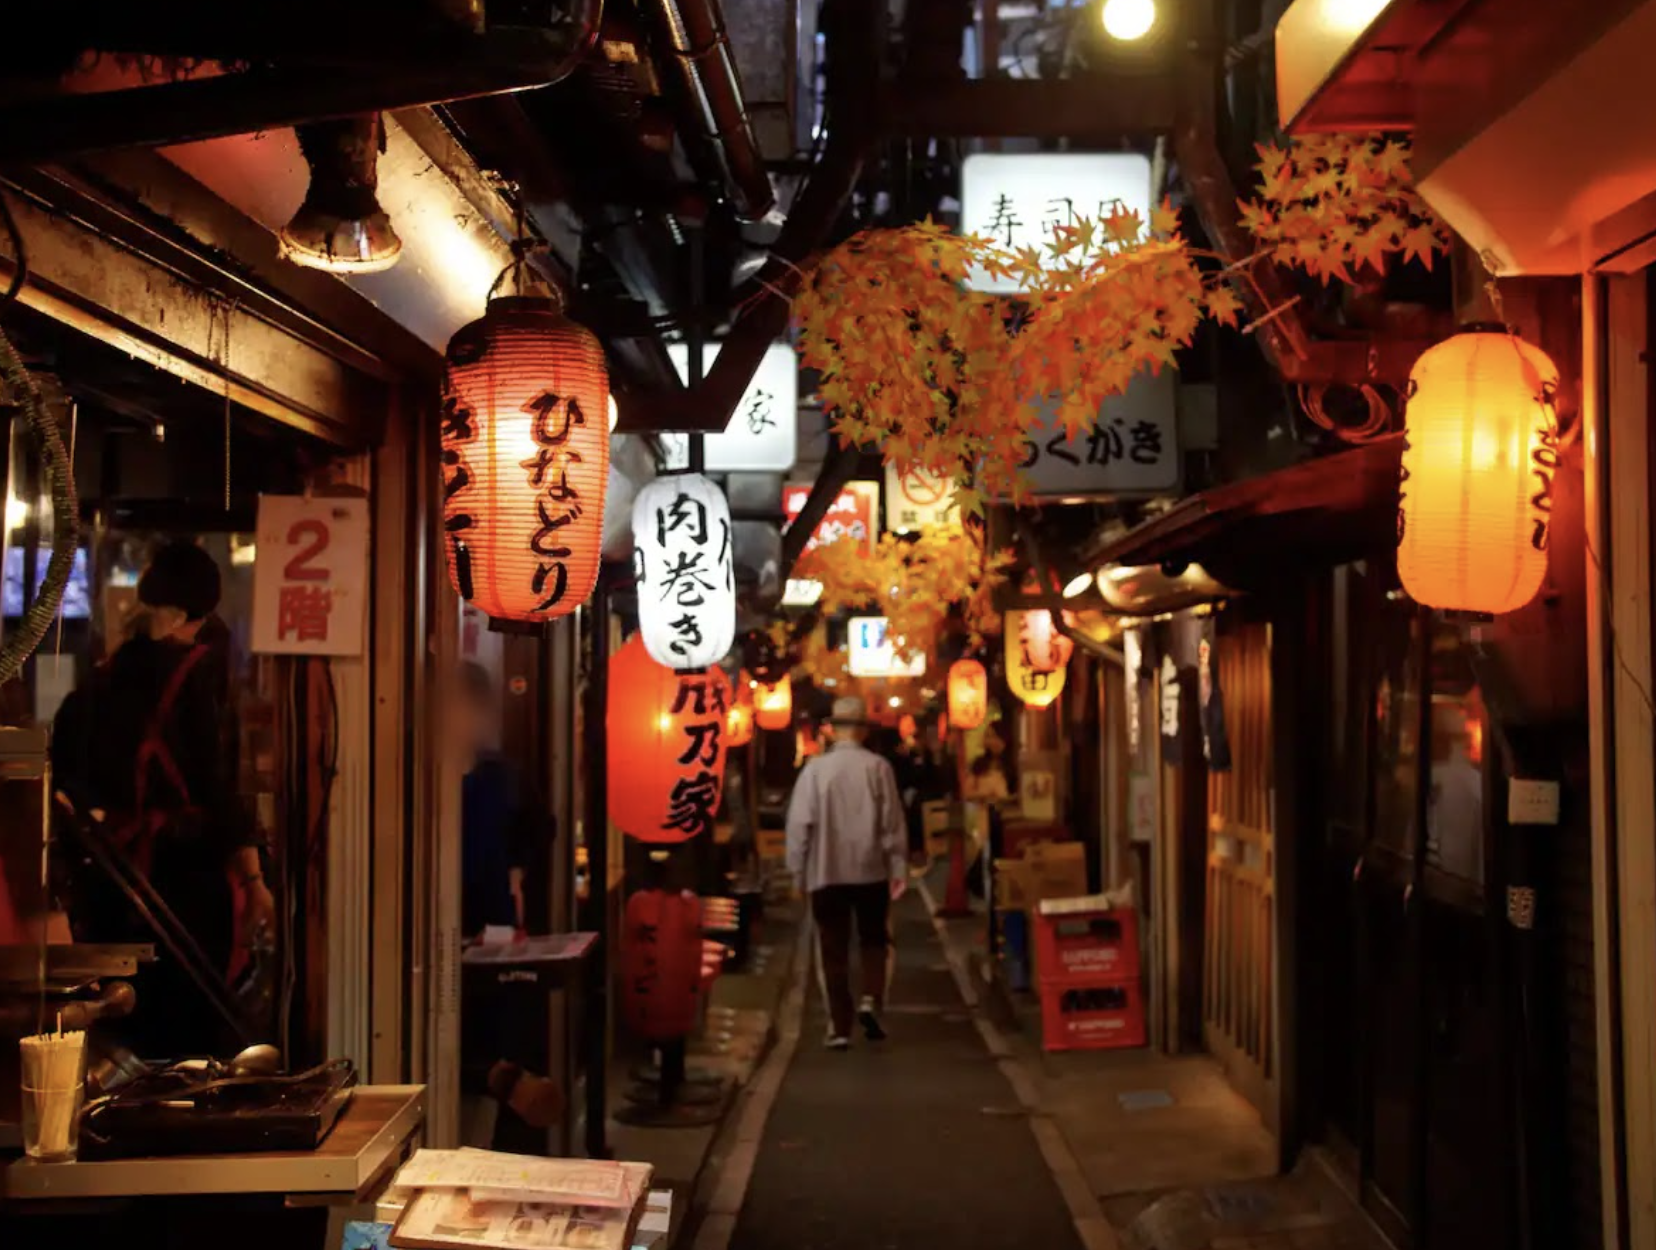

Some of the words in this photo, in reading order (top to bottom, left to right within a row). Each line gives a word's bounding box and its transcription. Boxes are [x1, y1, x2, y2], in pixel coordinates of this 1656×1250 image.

[278, 519, 332, 641] 2階
[520, 389, 585, 613] ひなどり
[656, 493, 716, 655] 肉巻き
